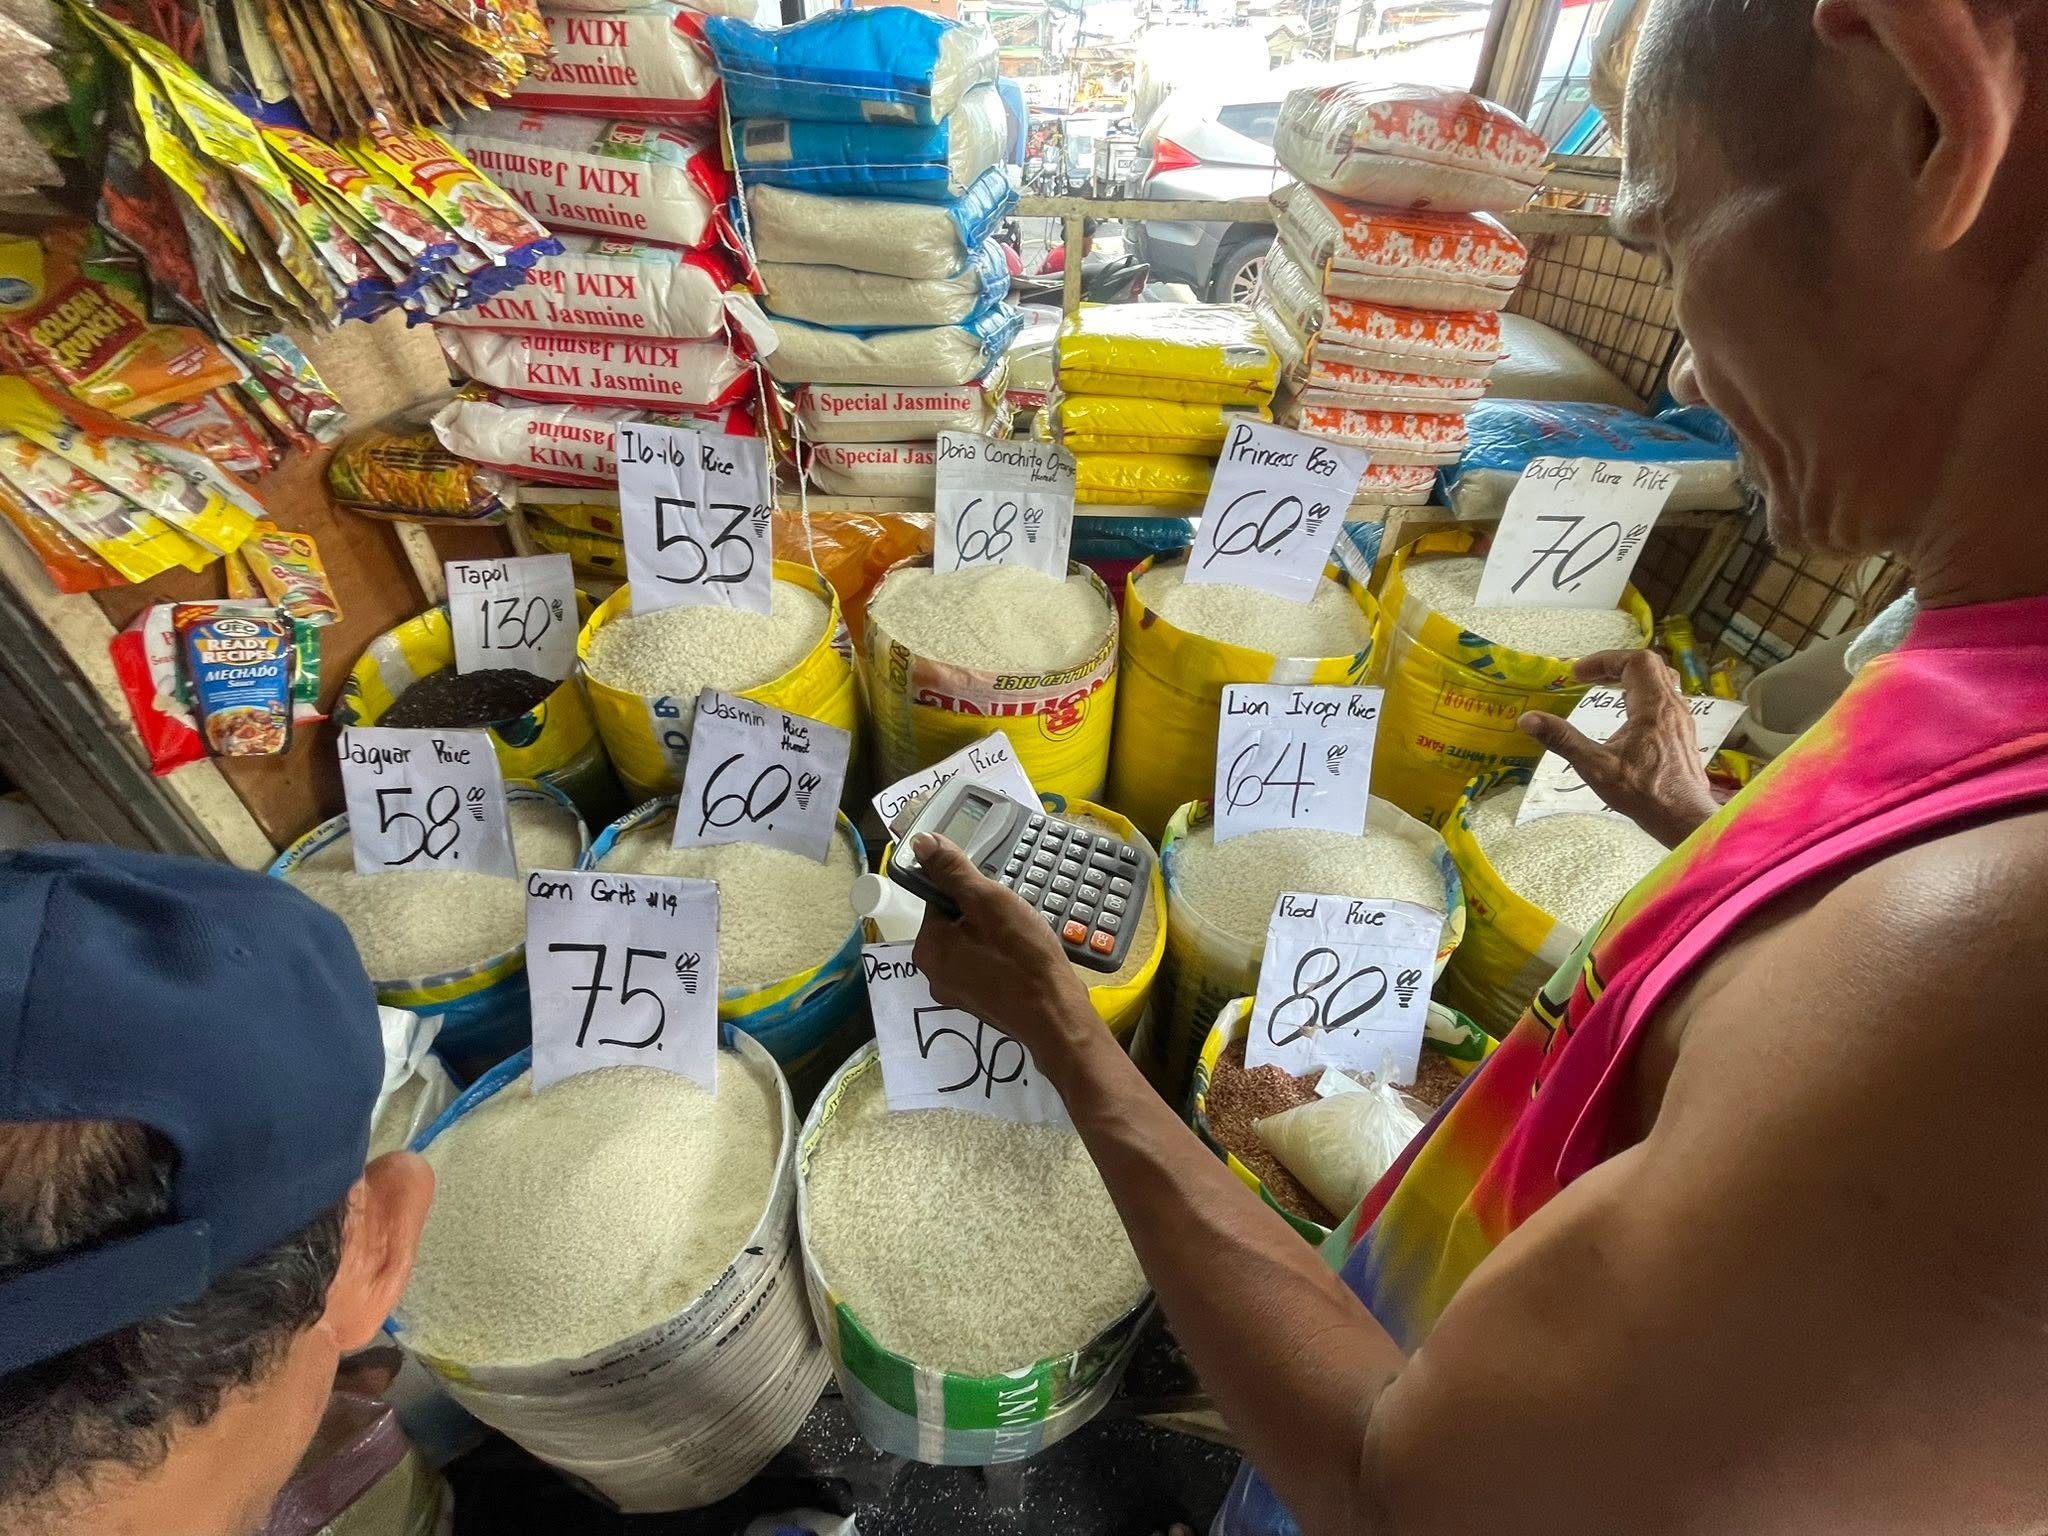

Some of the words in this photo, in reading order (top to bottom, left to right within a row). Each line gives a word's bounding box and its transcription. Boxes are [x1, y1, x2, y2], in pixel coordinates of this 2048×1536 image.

[567, 18, 629, 47] KIM
[467, 148, 568, 187] Jasmine
[578, 165, 640, 197] KIM
[546, 194, 648, 231] Jasmine
[527, 269, 566, 289] Jas
[576, 273, 637, 299] KIM
[477, 299, 537, 321] KIM
[547, 302, 645, 328] Jasmine
[521, 336, 615, 362] Jasmine
[624, 345, 680, 369] KIM
[527, 363, 583, 388] KIM
[591, 368, 682, 395] Jasmine
[821, 391, 888, 416] Special
[893, 392, 971, 411] Jasmine
[530, 446, 584, 470] KIM
[702, 445, 735, 475] Rice
[836, 448, 898, 468] Special
[903, 449, 936, 464] Jas
[984, 441, 1042, 469] Conchita
[1229, 424, 1299, 467] Princess
[1306, 447, 1337, 476] Bea
[1633, 466, 1670, 490] Pilit
[454, 564, 509, 589] Tapol
[202, 650, 277, 664] RECIPES
[207, 639, 269, 651] READY
[205, 665, 278, 682] MECHADO
[993, 675, 1040, 690] RICE
[701, 693, 765, 727] Jasmin
[782, 714, 808, 739] Rice
[1228, 690, 1269, 715] Lion
[1347, 694, 1376, 719] Rice
[339, 732, 411, 774] Jaguar
[432, 739, 471, 765] Rice
[968, 748, 1008, 774] Rice
[528, 873, 573, 900] Corn
[591, 879, 636, 905] Grits
[1279, 895, 1318, 918] Red
[1345, 901, 1387, 926] Rice
